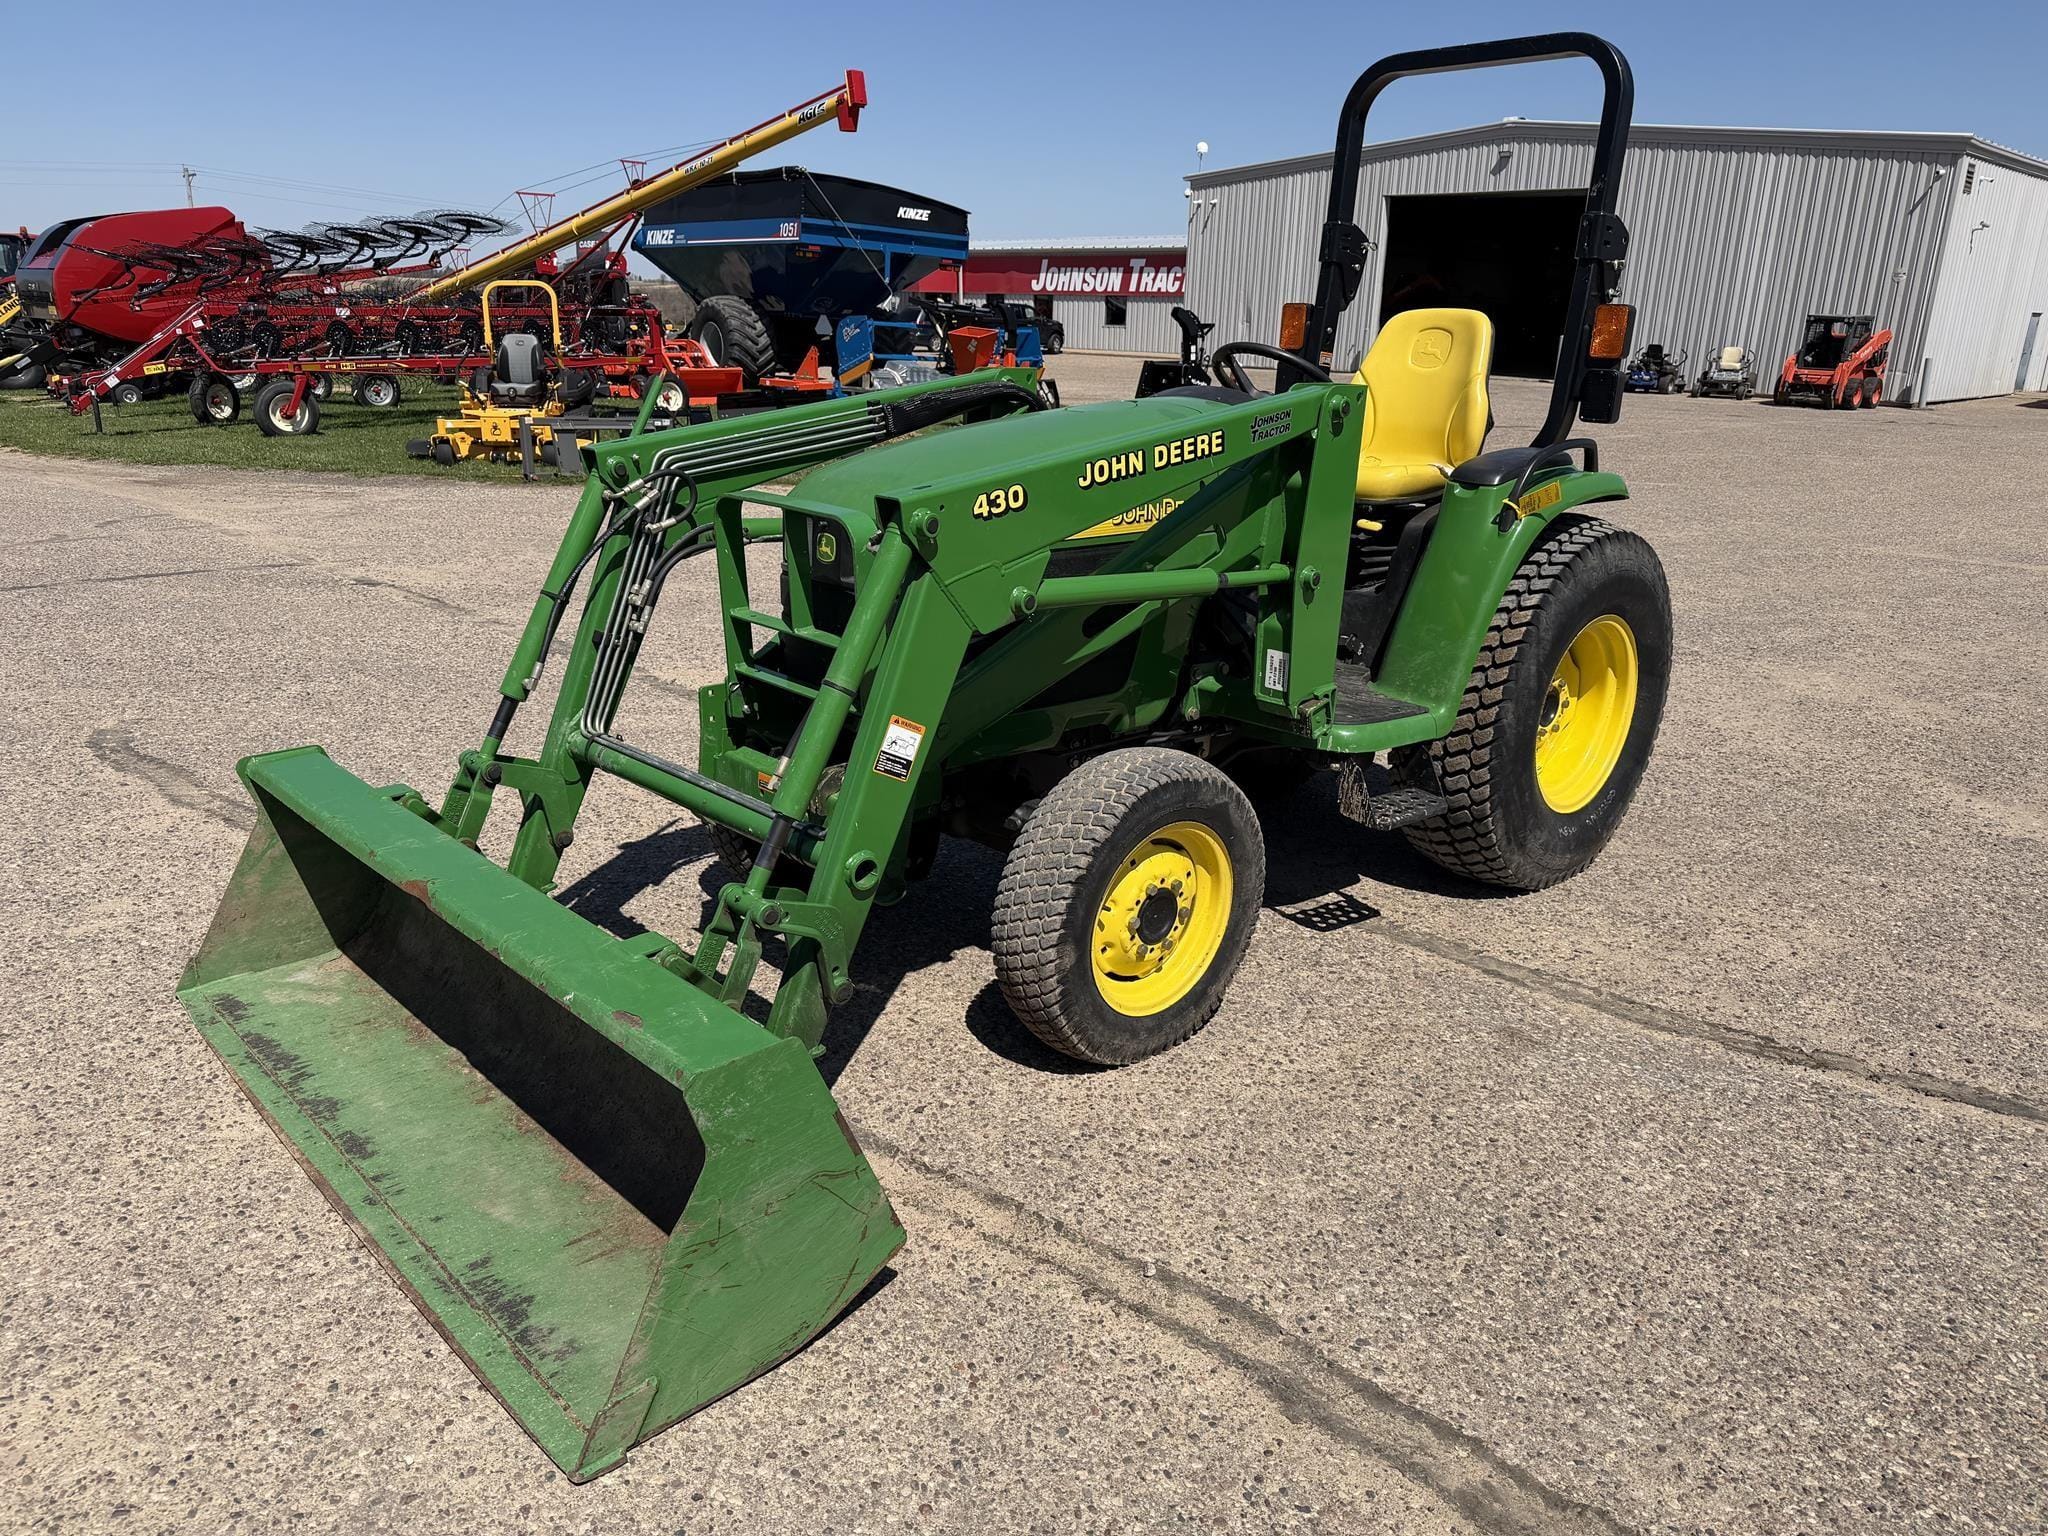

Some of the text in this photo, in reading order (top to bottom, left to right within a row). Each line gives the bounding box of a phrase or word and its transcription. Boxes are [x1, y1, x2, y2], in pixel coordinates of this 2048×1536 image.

[897, 206, 931, 221] KINZE
[646, 229, 676, 245] KINZE
[779, 222, 798, 237] 1051
[1031, 258, 1124, 292] JOHNSON
[1251, 409, 1292, 429] JOHNSON
[1252, 422, 1291, 442] TRACTOR
[1078, 430, 1225, 488] JOHN DEERE
[973, 484, 1028, 520] 430
